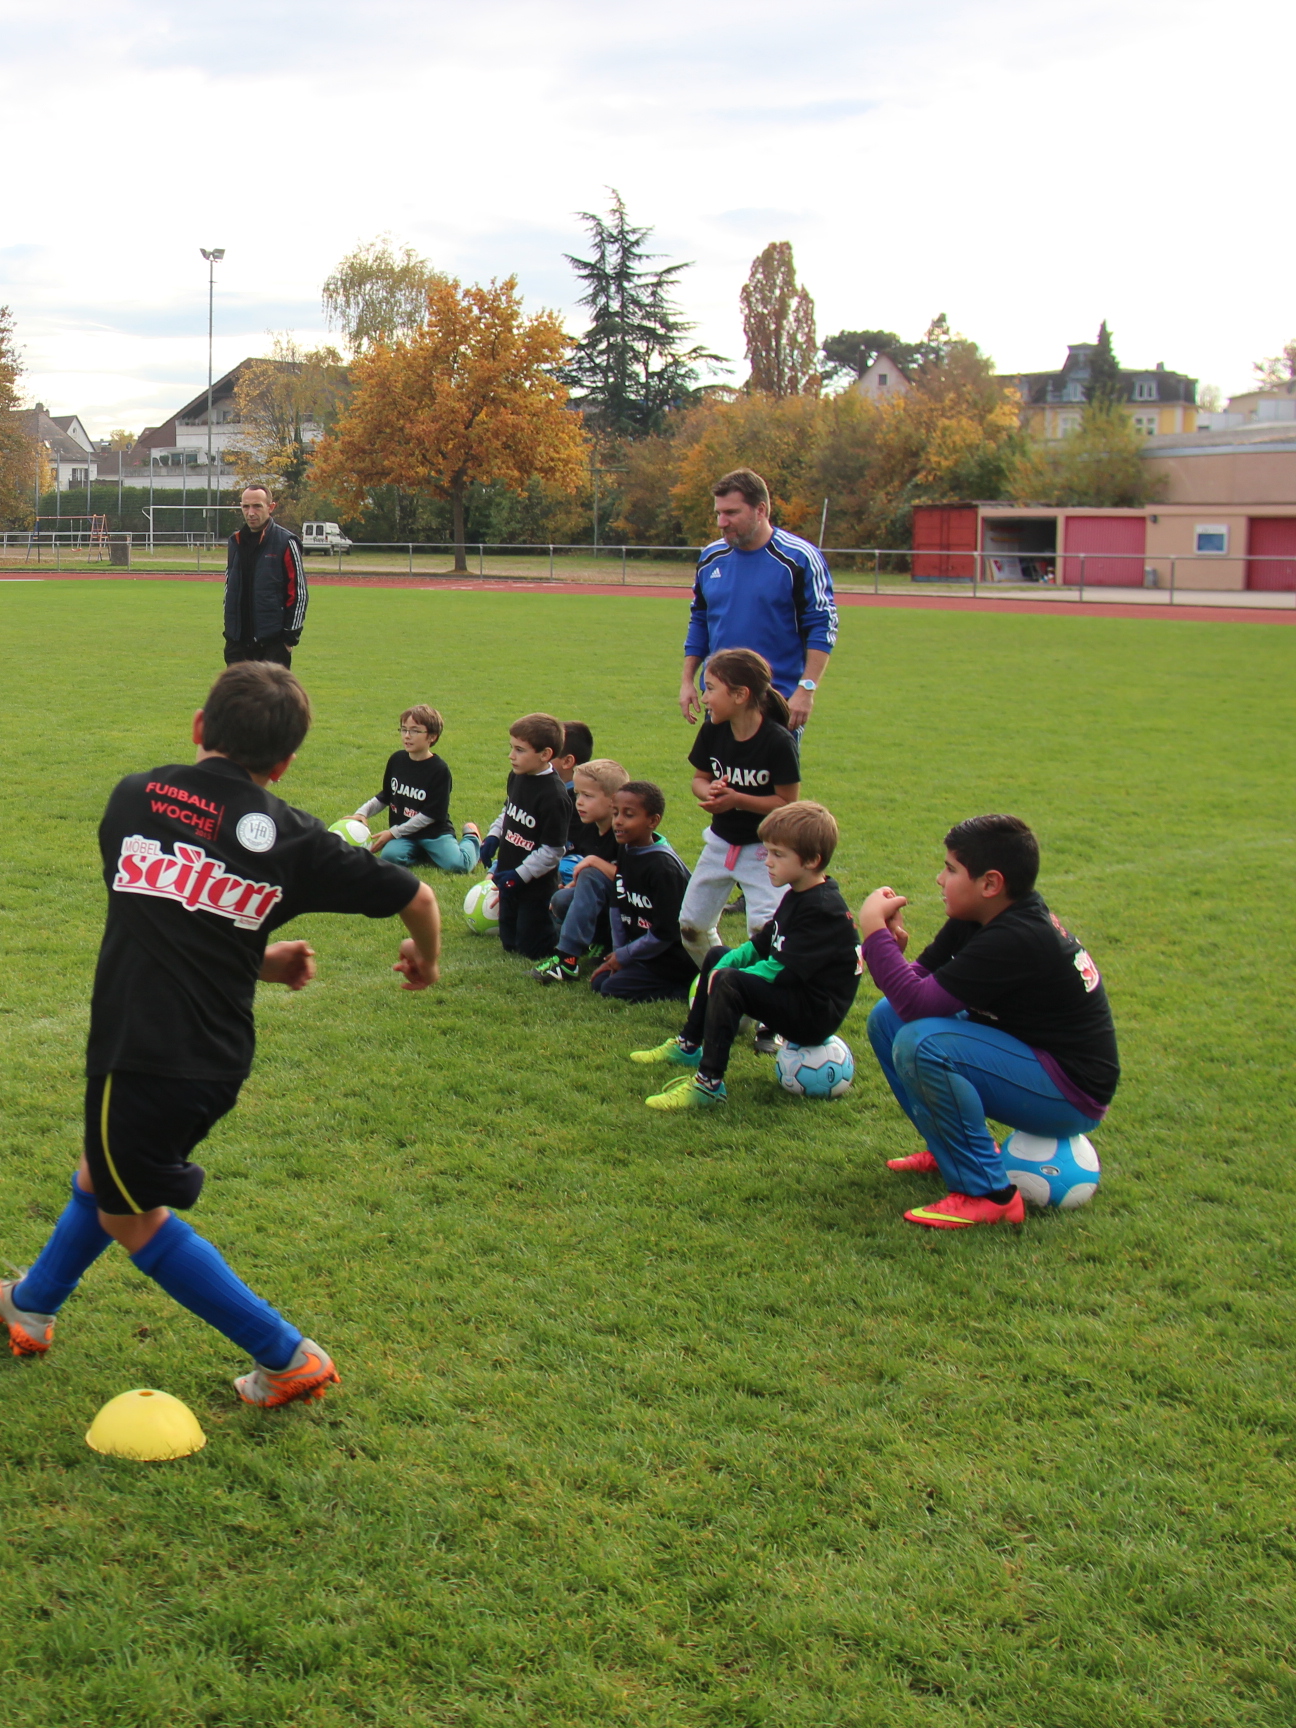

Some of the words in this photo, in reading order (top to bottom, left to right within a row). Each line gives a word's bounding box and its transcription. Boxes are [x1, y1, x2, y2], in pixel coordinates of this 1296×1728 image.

[726, 766, 770, 787] JAKO
[397, 783, 426, 801] JAKO
[151, 800, 215, 832] WOCHE
[507, 802, 536, 828] JAKO
[124, 838, 160, 856] MÖBEL
